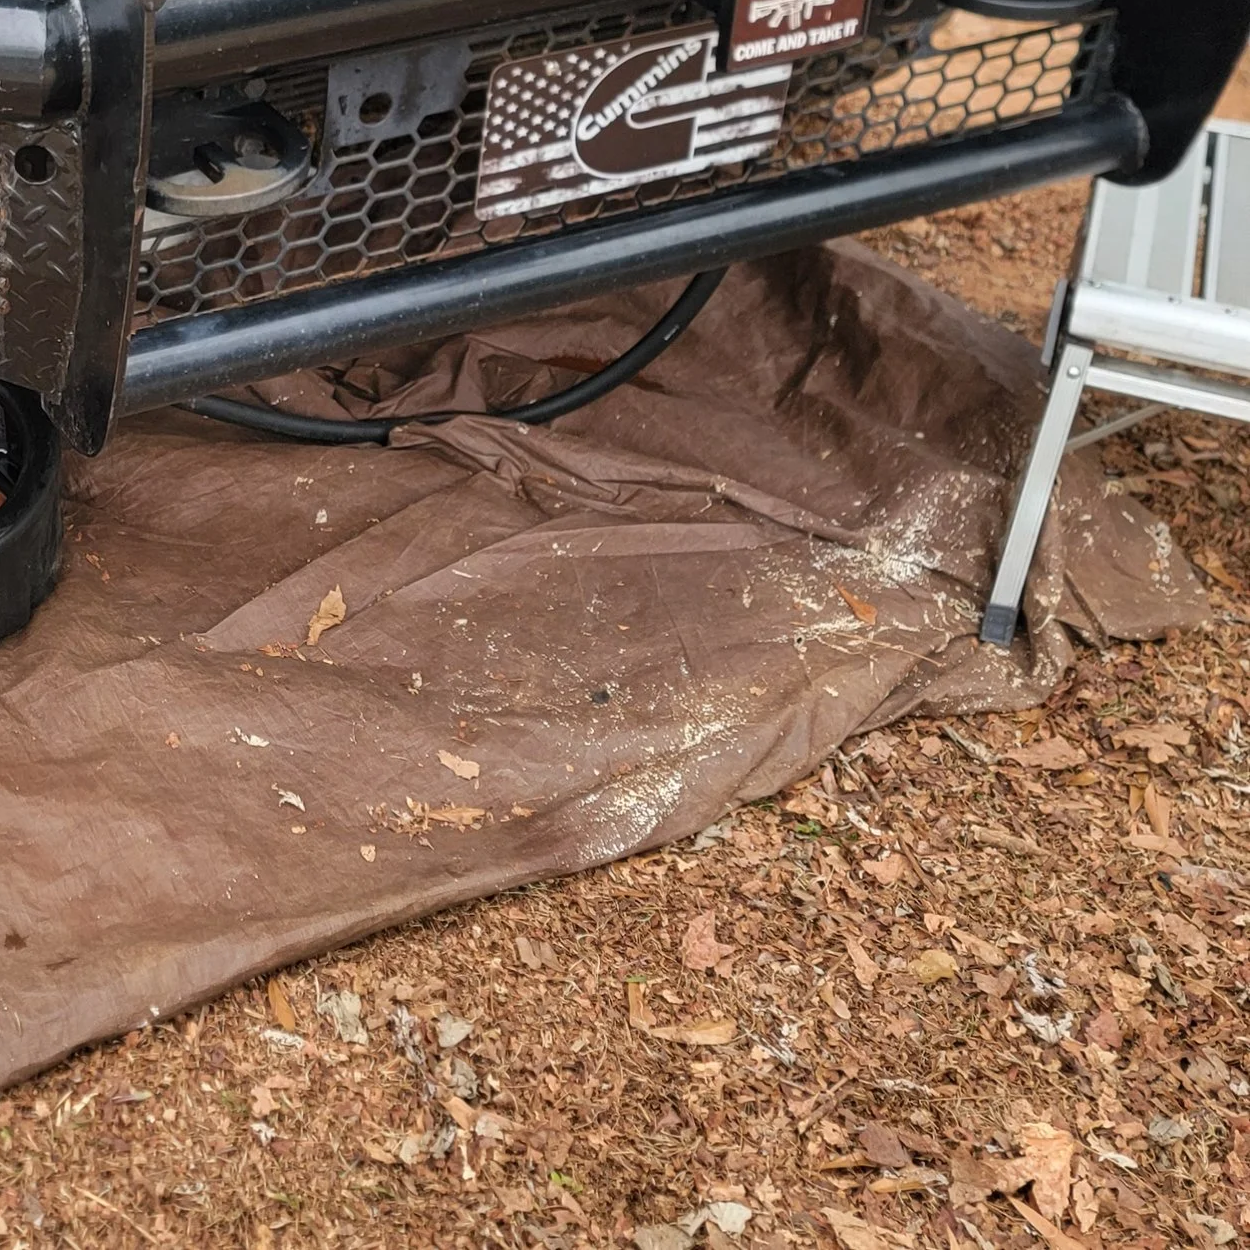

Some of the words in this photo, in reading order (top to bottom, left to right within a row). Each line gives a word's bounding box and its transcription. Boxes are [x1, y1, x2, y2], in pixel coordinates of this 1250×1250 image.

[733, 38, 776, 62] COME
[777, 31, 807, 53] AND
[808, 22, 844, 46] TAKE
[843, 18, 859, 37] IT
[576, 38, 703, 141] Cummins
